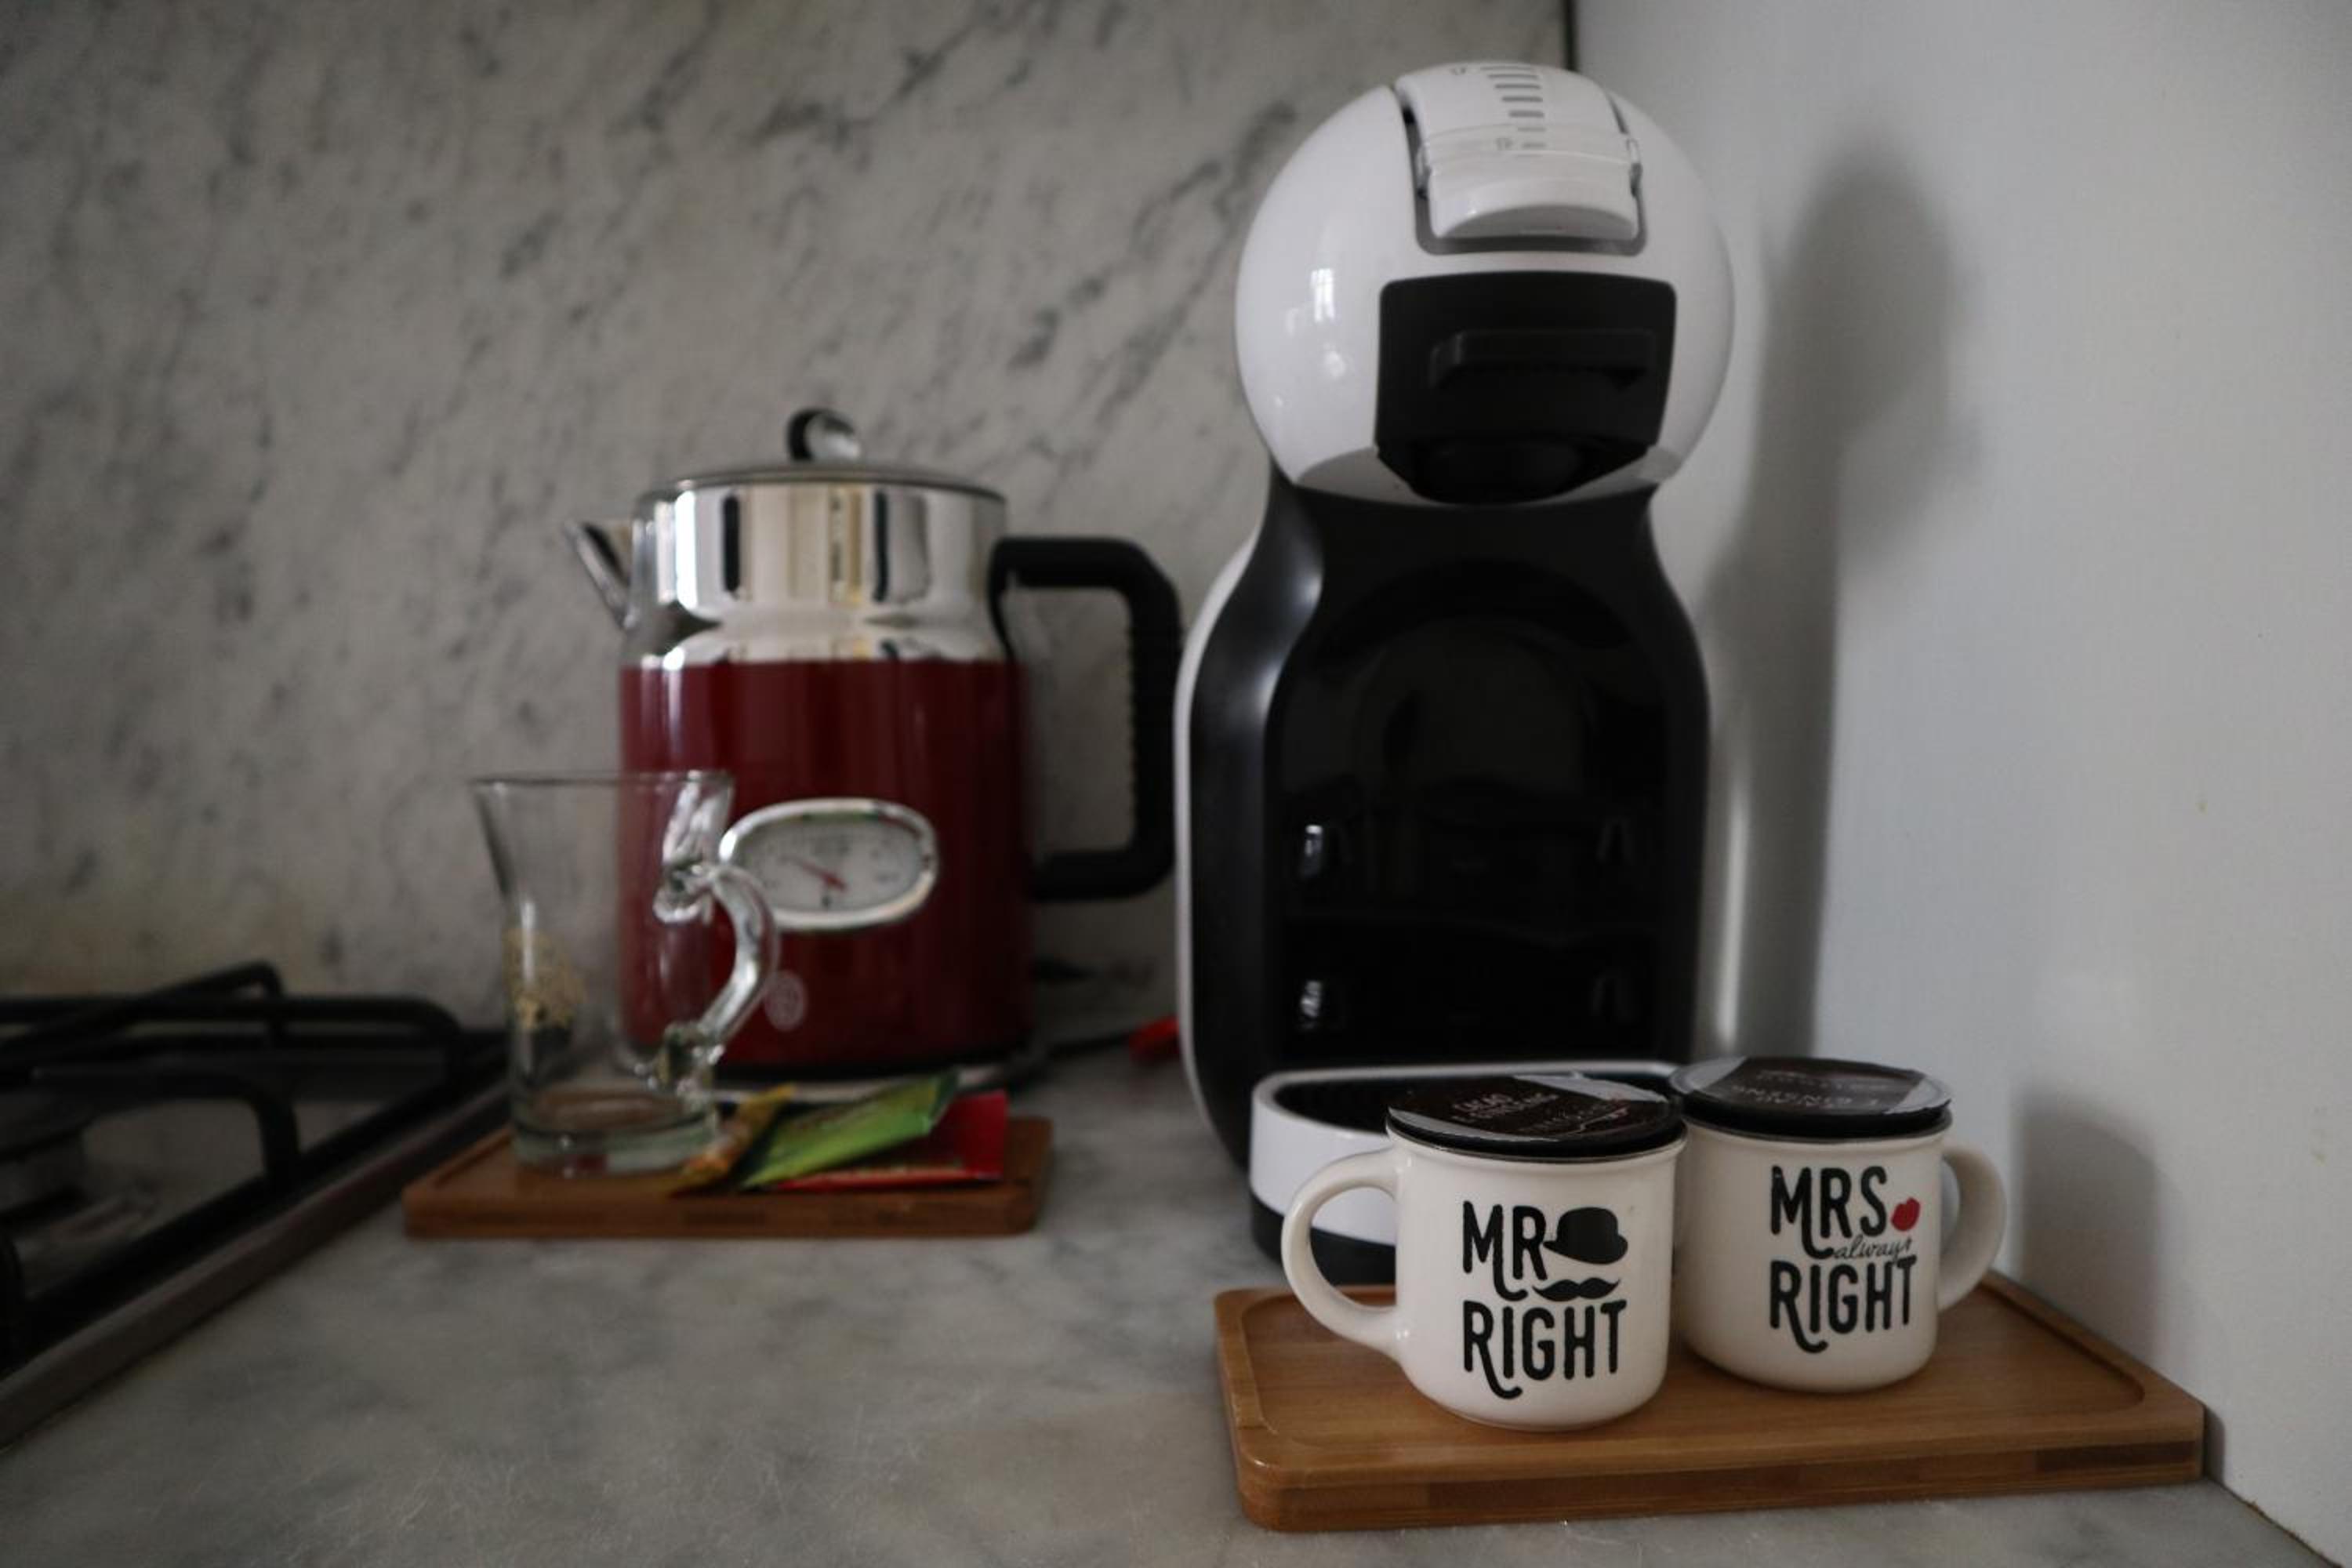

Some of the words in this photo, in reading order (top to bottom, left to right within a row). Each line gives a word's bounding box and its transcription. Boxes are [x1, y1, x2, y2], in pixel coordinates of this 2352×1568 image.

[1463, 1200, 1548, 1301] MR
[1771, 1165, 1887, 1259] MRS
[1834, 1234, 1912, 1265] always
[1463, 1300, 1627, 1399] RIGHT
[1769, 1254, 1917, 1353] RIGHT
